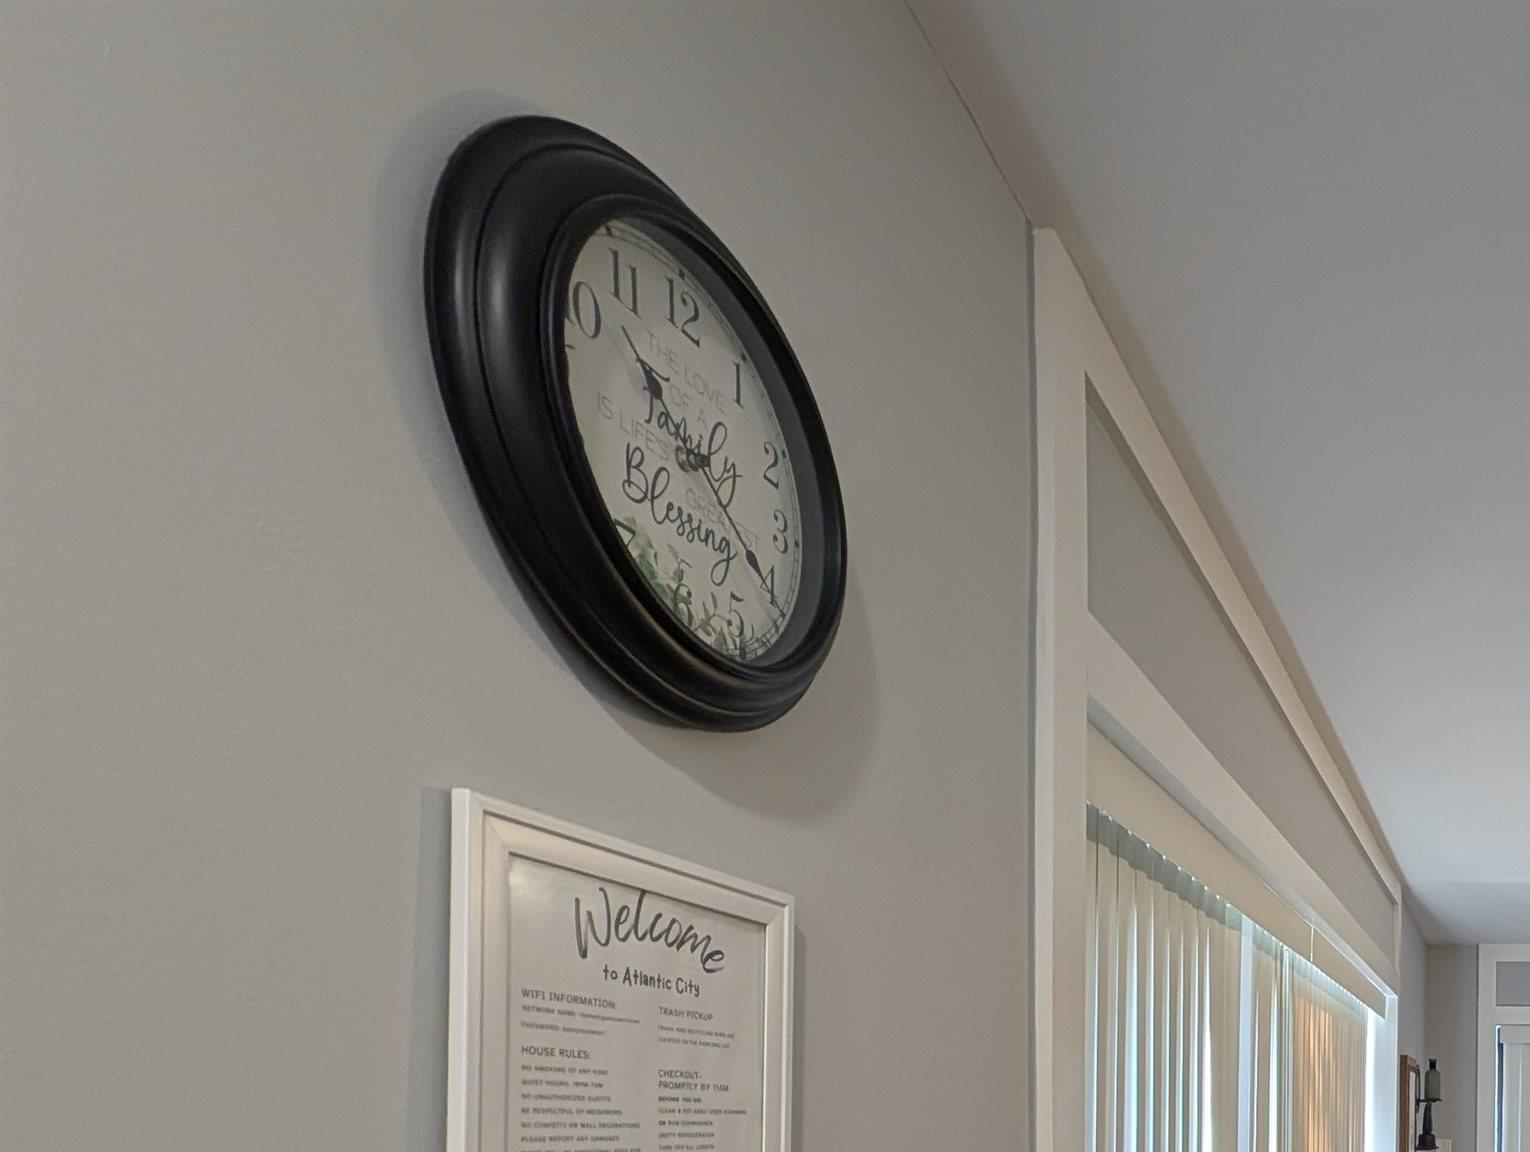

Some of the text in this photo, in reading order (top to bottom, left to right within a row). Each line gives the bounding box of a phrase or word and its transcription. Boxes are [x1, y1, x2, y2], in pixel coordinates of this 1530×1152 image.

[610, 247, 641, 319] 11
[564, 280, 600, 339] 0
[665, 274, 700, 347] 12
[733, 361, 744, 409] 1
[763, 440, 780, 490] 2
[622, 442, 738, 586] Blessing
[773, 509, 789, 554] 3
[727, 591, 745, 638] 5
[574, 886, 726, 974] Welcome
[521, 988, 546, 999] WIFI
[603, 964, 700, 998] to Atlantic City
[658, 1006, 685, 1017] TRASH
[521, 1046, 556, 1057] HOUSE
[658, 1080, 698, 1090] PROMPTLY
